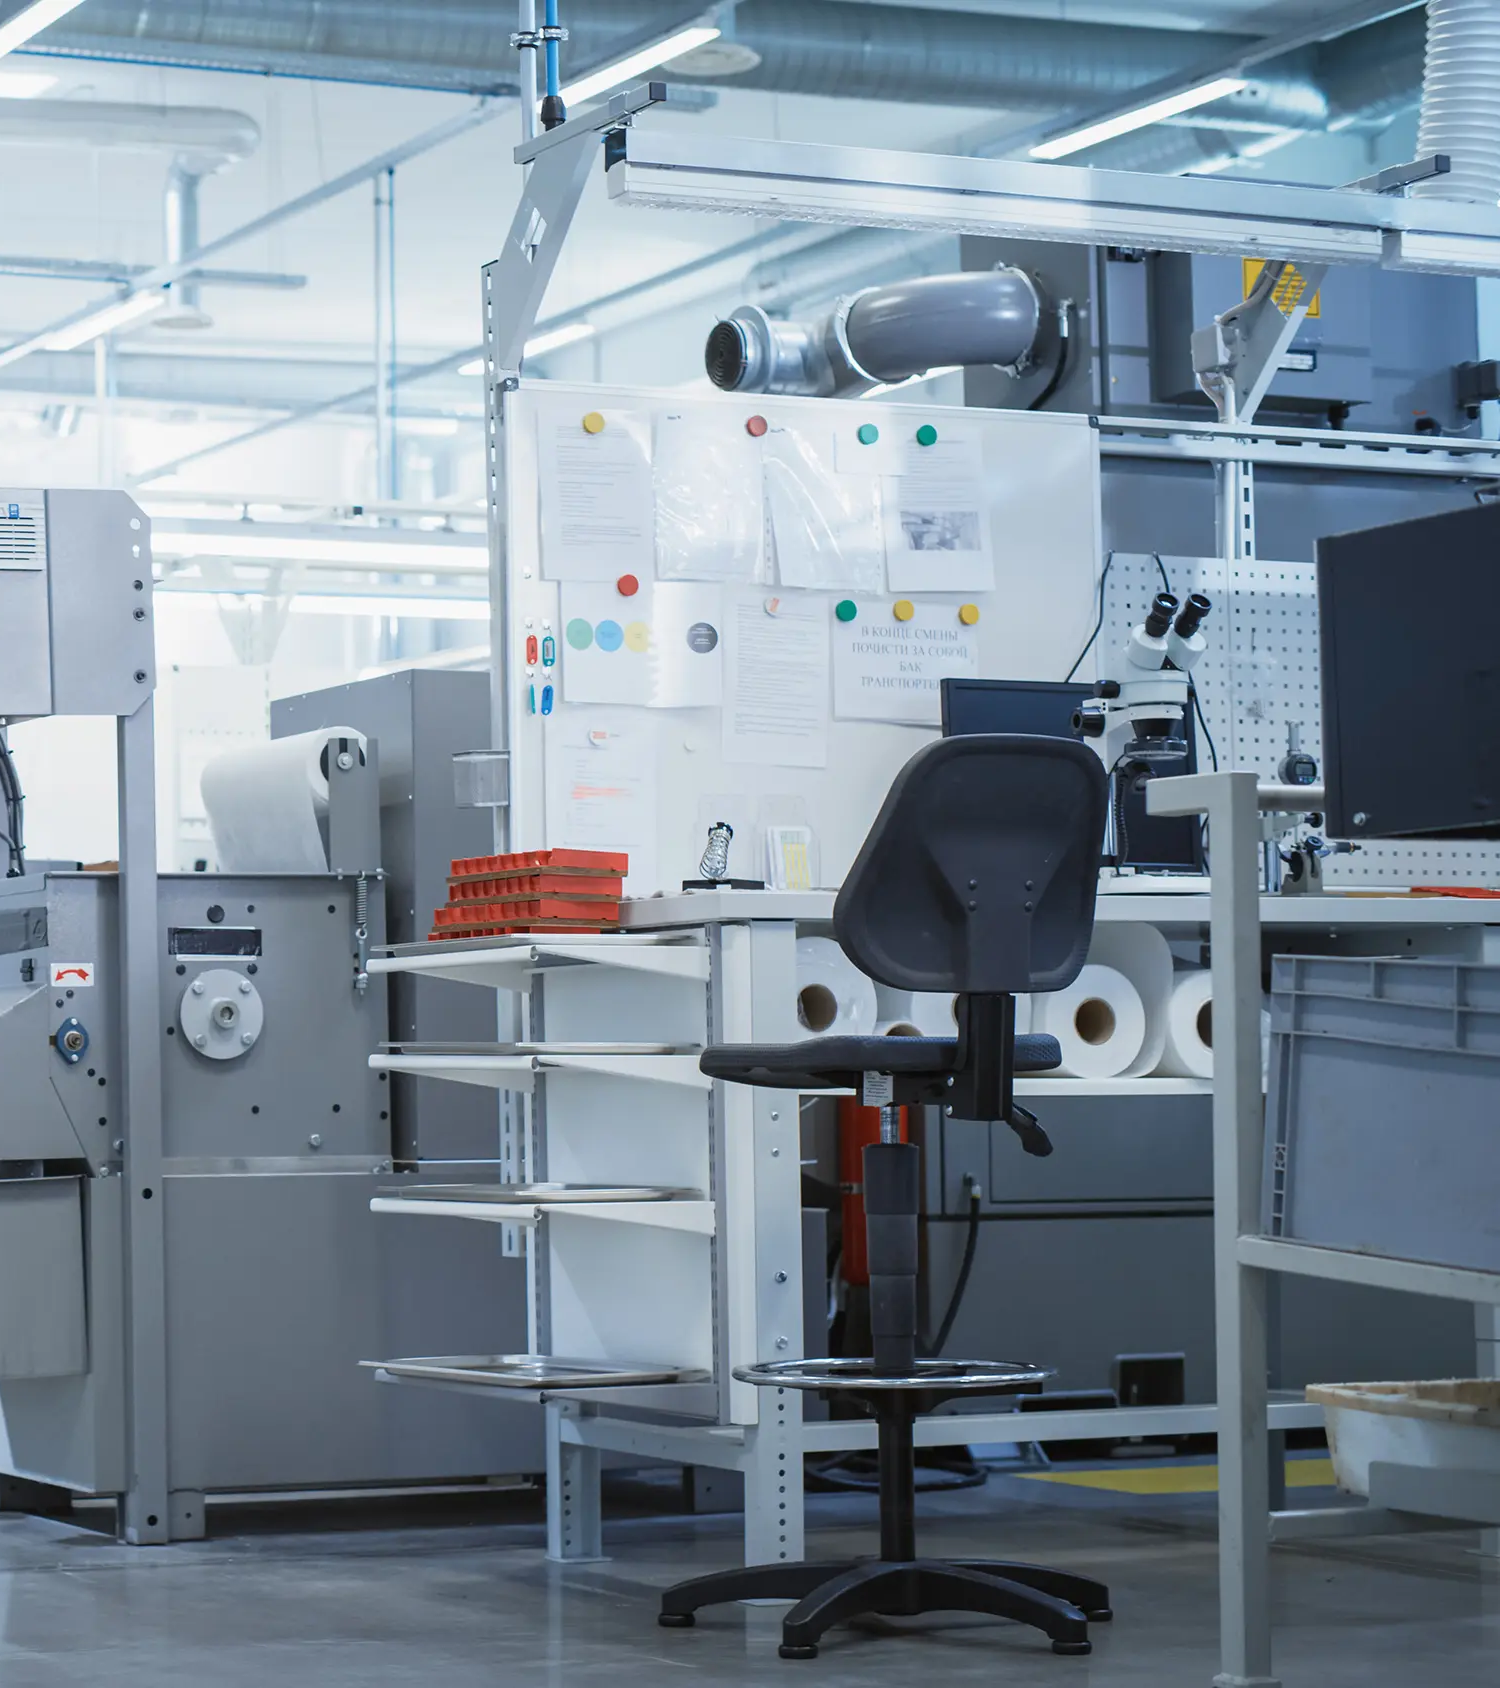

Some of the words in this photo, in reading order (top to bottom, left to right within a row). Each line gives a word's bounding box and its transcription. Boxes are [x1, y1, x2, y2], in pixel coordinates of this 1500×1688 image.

[861, 627, 869, 637] В
[872, 627, 912, 640] КОНЦЕ
[915, 630, 958, 641] СМЕНЫ
[852, 642, 908, 655] ПОЧИСТИ
[911, 645, 925, 656] ЗА
[899, 661, 922, 673] БАК
